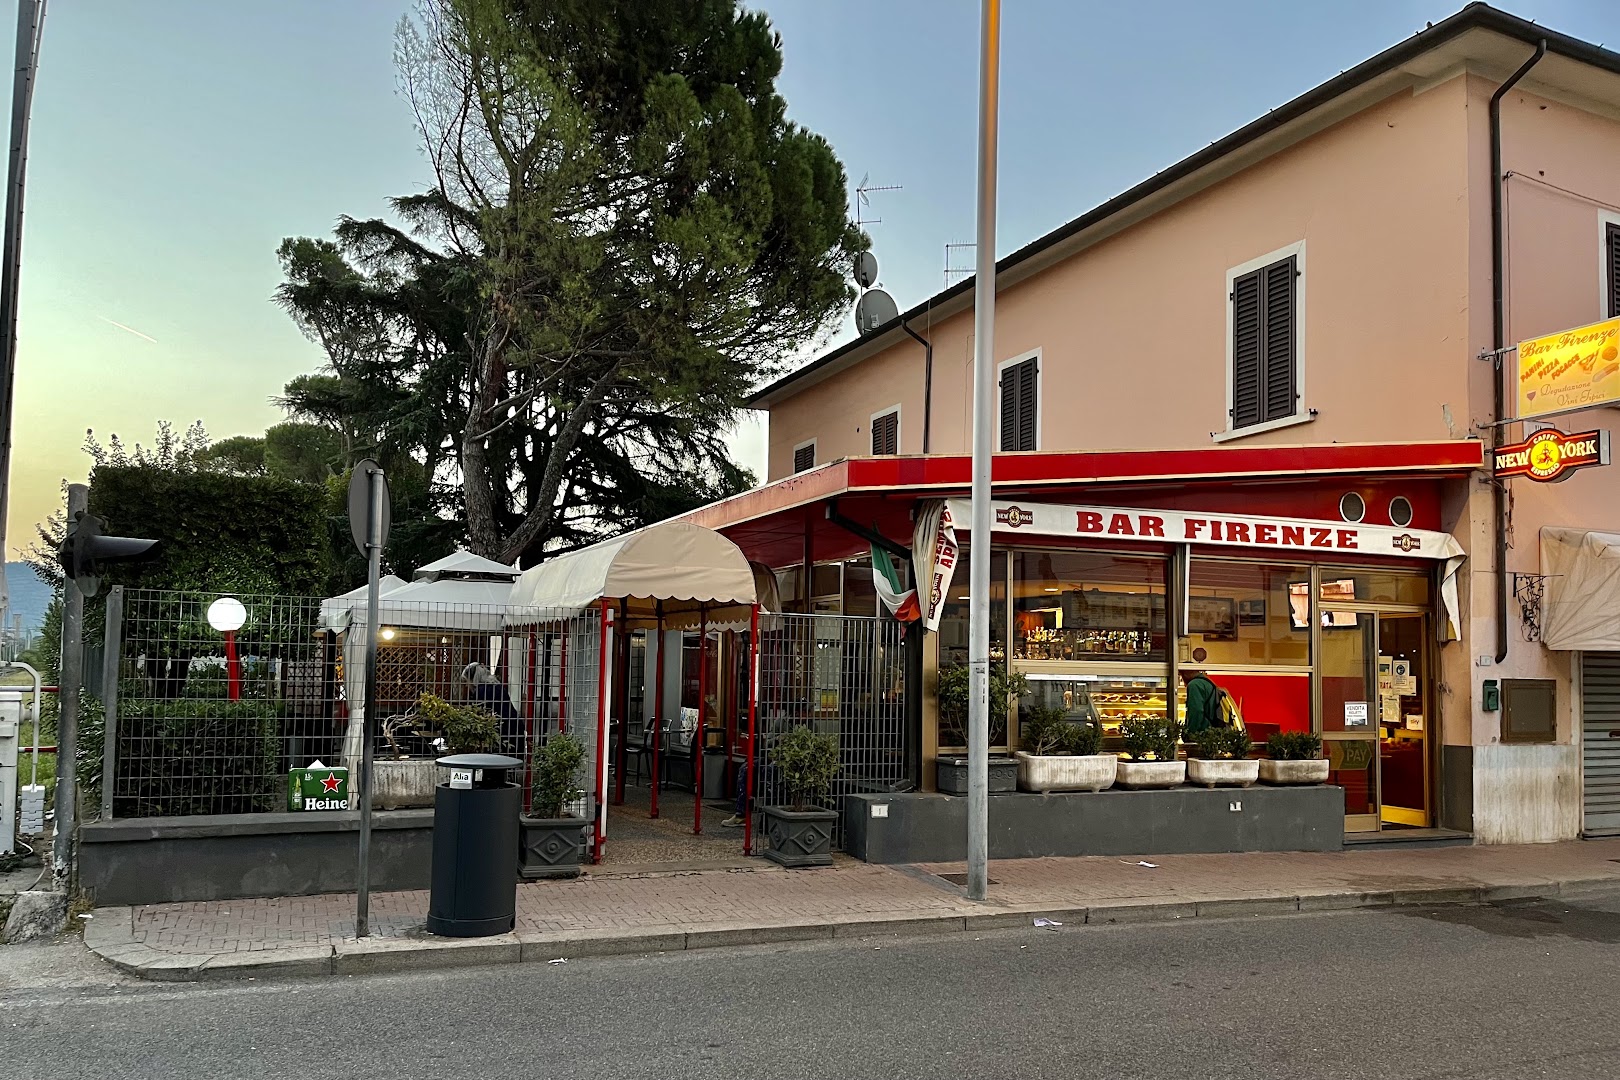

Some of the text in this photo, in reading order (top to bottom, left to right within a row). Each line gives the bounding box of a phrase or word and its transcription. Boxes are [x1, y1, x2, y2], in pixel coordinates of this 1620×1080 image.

[1520, 327, 1620, 358] Bar Firenze
[1520, 358, 1545, 382] PANINI
[1537, 358, 1560, 379] PIZZA
[1551, 353, 1581, 380] FOCACCE
[1495, 439, 1598, 470] NEW YORK
[1531, 462, 1560, 476] ESPRESSO
[1076, 511, 1359, 549] BAR FIRENZE
[1346, 748, 1367, 762] PAY
[453, 772, 469, 780] Alia
[304, 797, 348, 810] Heine
